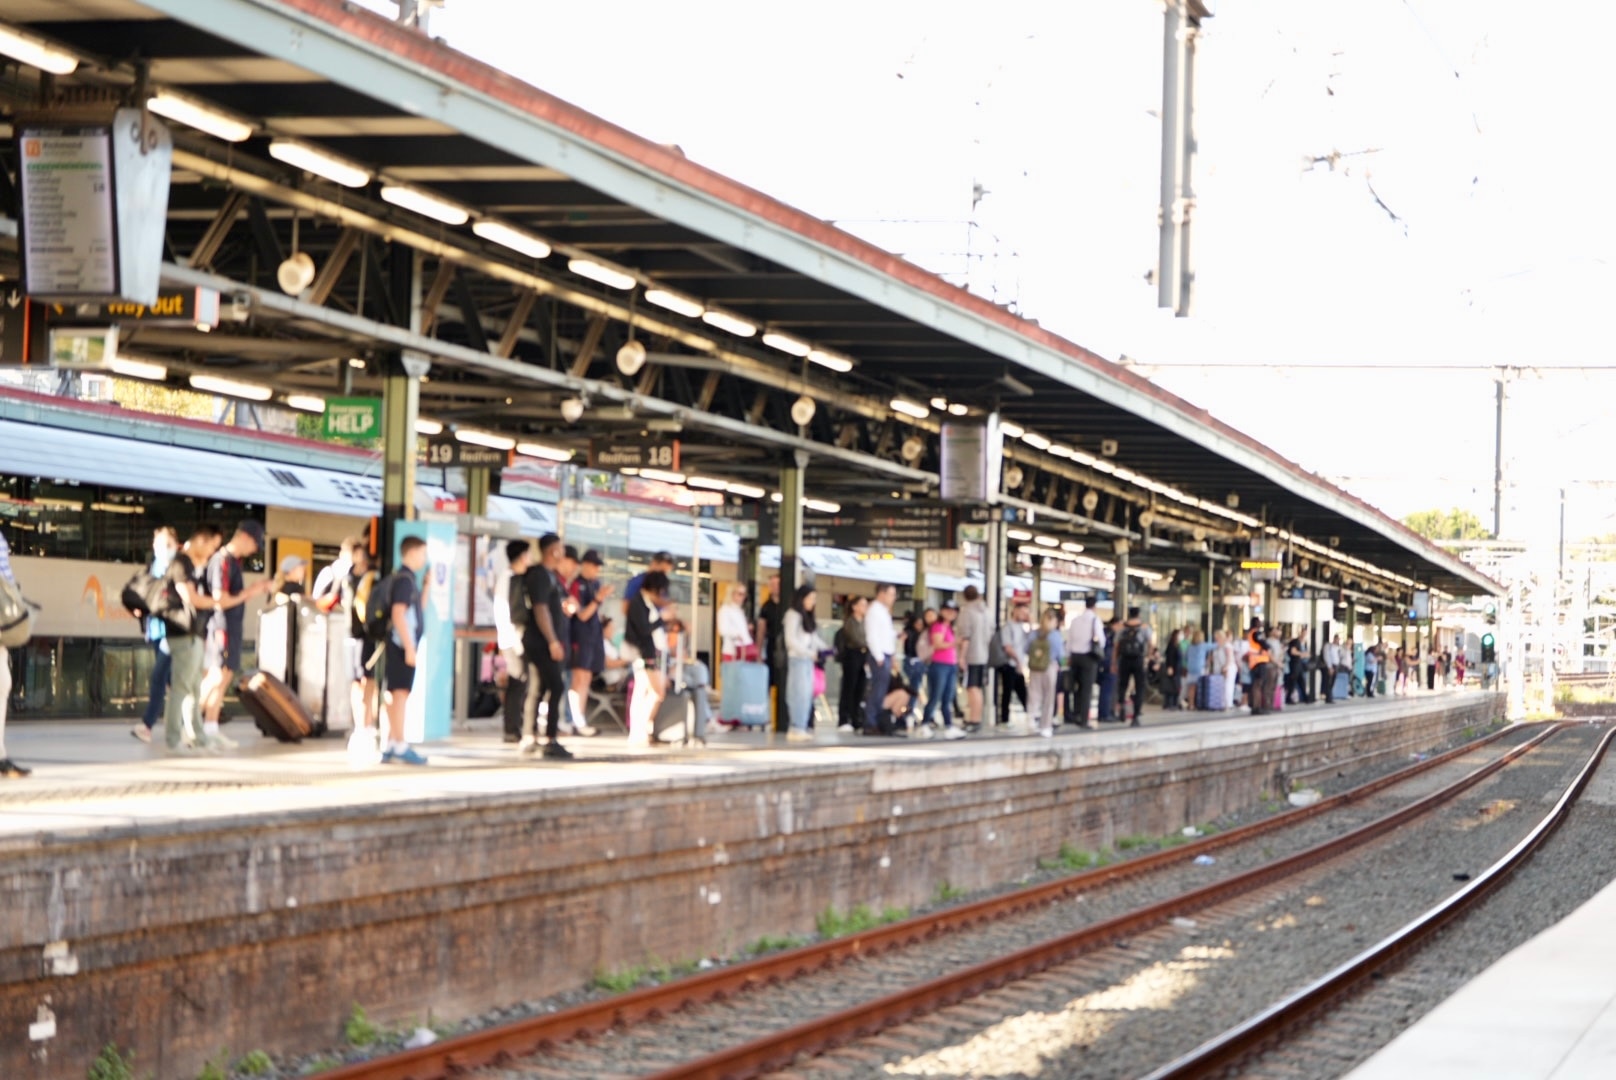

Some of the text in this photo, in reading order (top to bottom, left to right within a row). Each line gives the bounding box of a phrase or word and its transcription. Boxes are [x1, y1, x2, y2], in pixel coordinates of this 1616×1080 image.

[108, 294, 184, 319] Way out
[328, 413, 374, 434] HELP
[430, 443, 453, 464] 19
[459, 450, 502, 463] Redfern
[598, 445, 673, 466] Redfern 18
